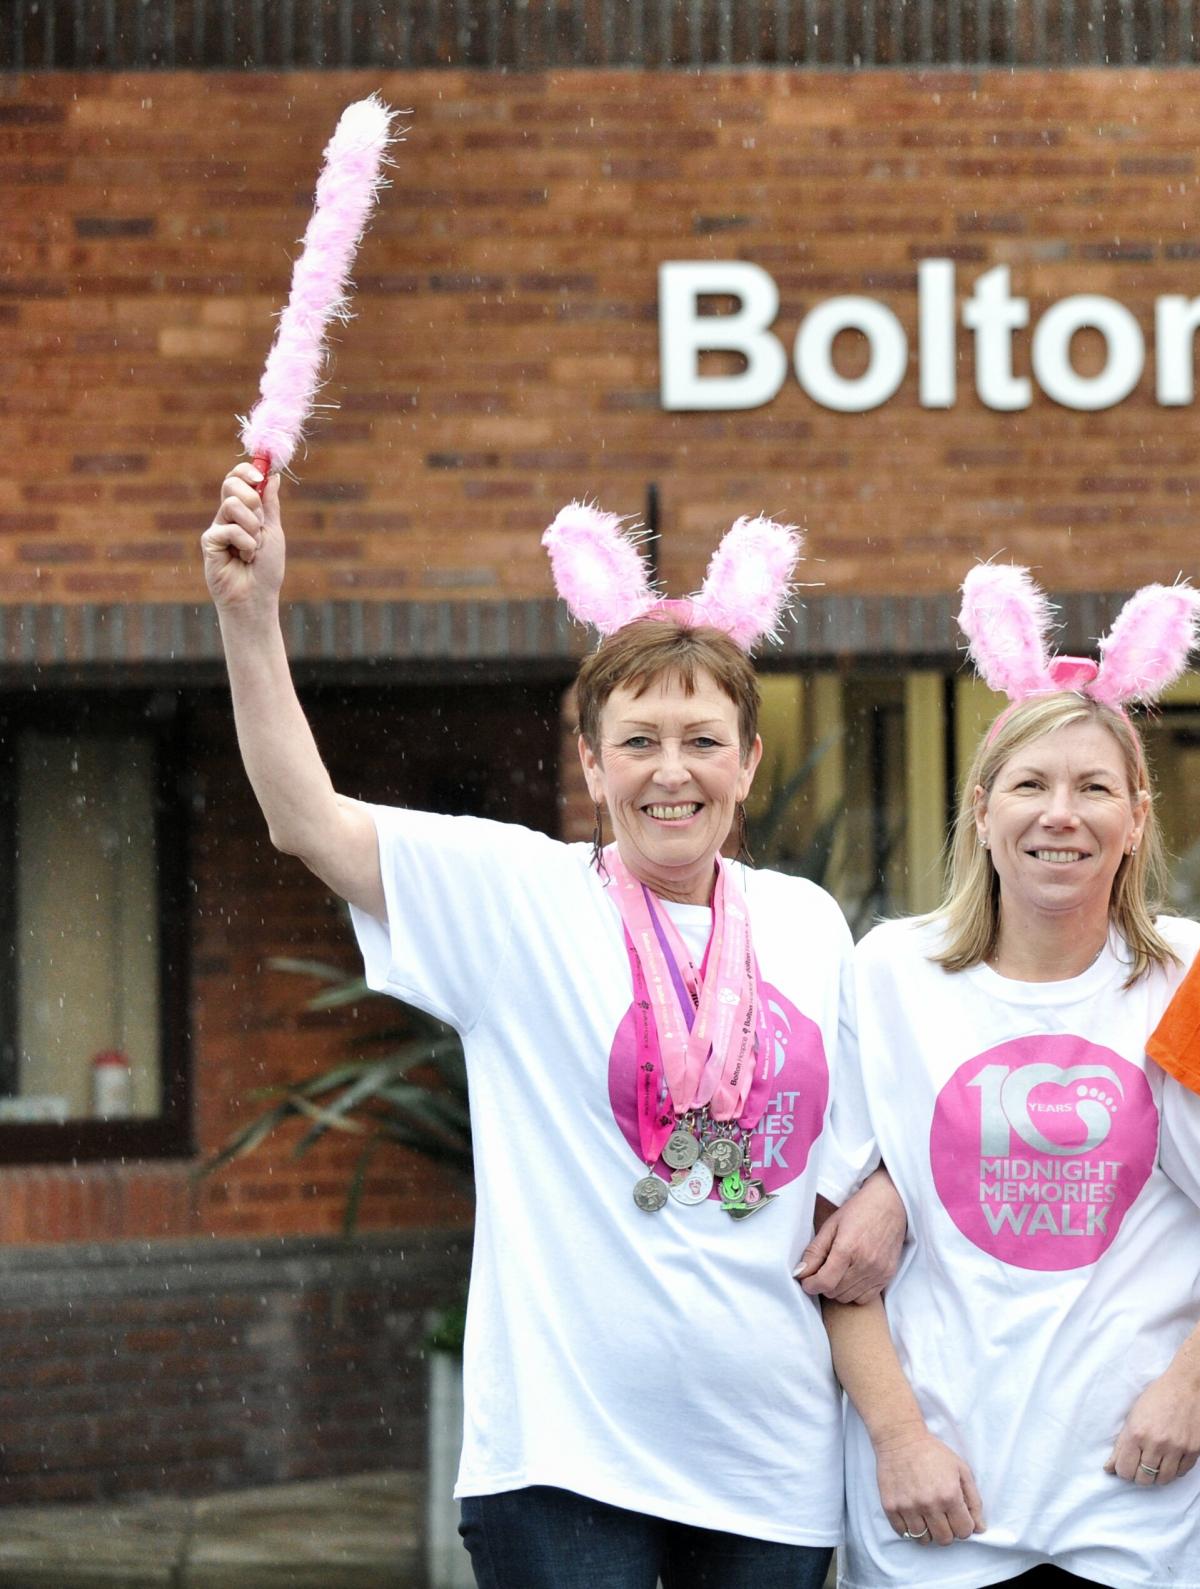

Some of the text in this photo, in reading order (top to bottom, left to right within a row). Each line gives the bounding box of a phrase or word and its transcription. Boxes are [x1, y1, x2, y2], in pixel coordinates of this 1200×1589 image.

[1027, 1102, 1073, 1114] YEARS
[979, 1159, 1124, 1182] MIDNIGHT
[979, 1181, 1118, 1203] MEMORIES
[980, 1202, 1108, 1237] WALK
